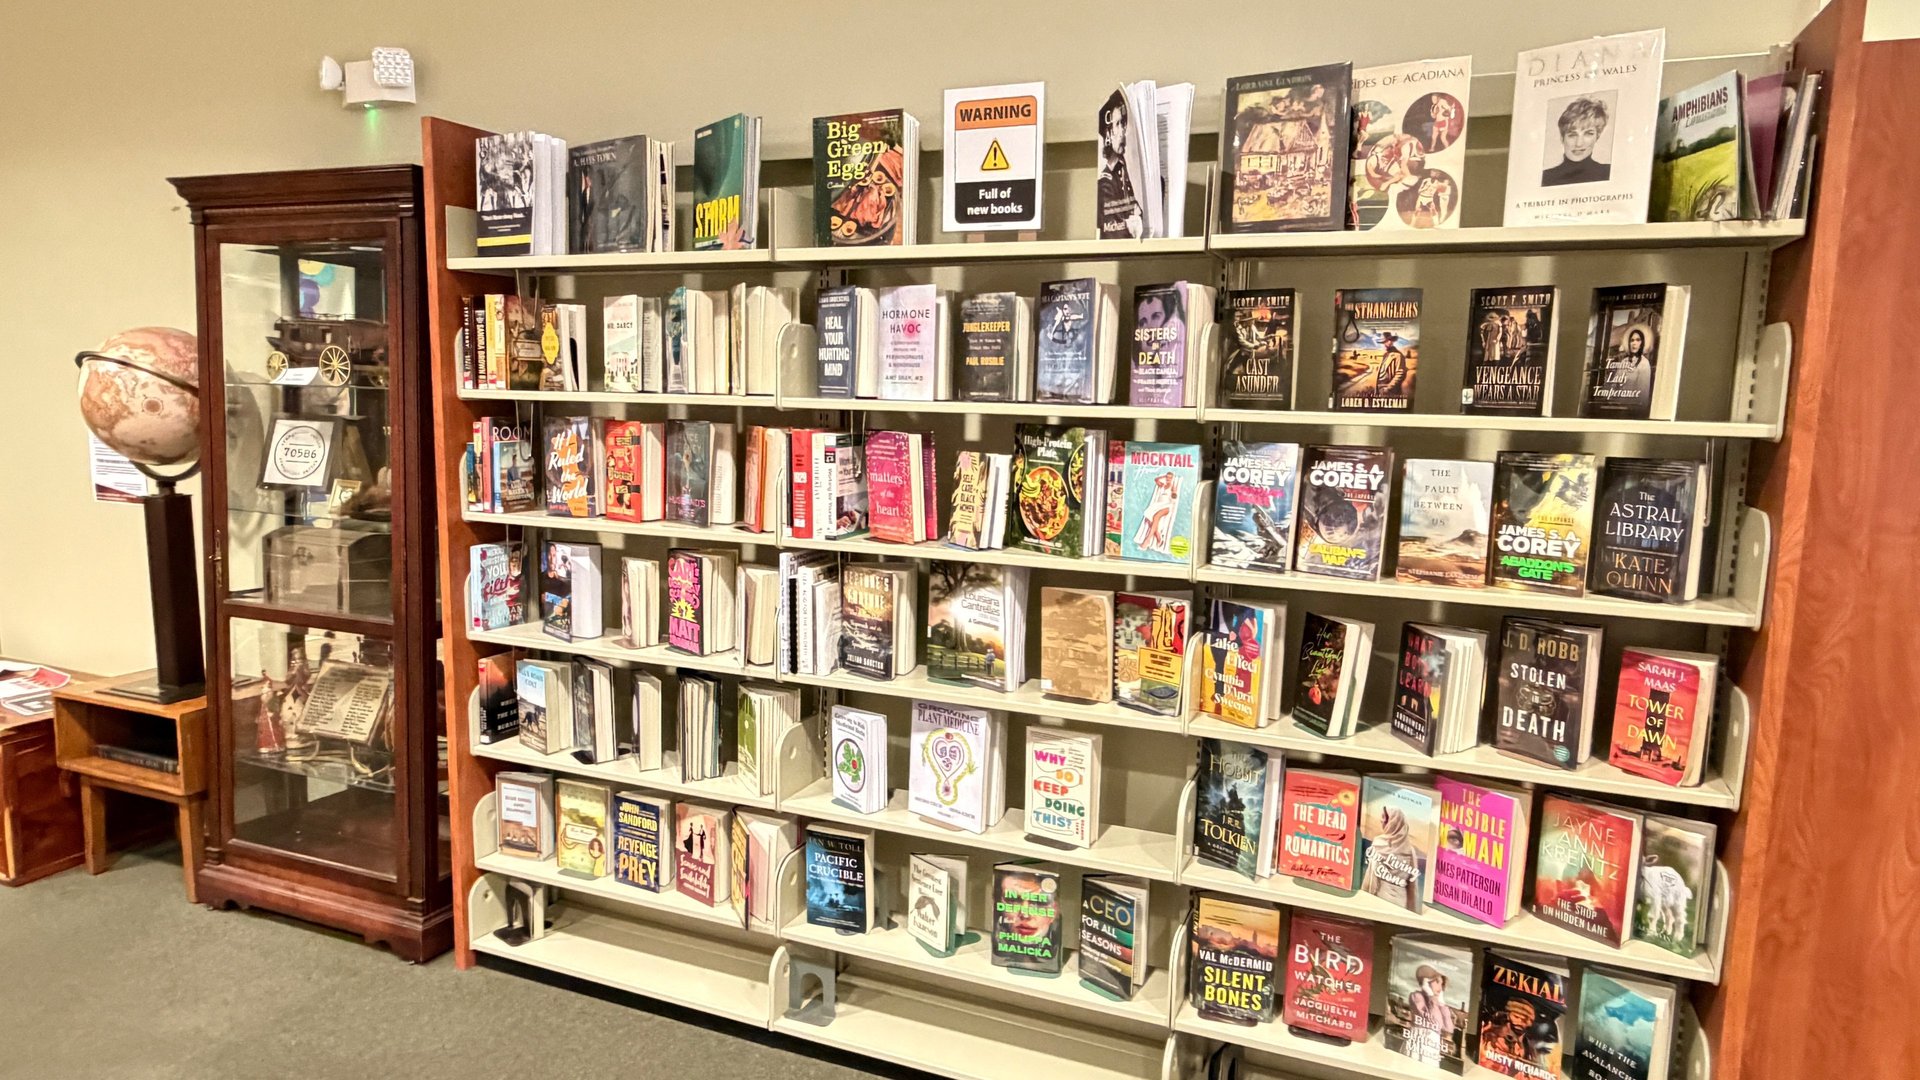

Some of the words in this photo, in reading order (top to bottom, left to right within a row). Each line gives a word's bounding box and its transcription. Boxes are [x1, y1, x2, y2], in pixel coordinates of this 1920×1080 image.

[1528, 43, 1646, 76] DIAN
[1383, 76, 1398, 86] OF
[1403, 68, 1464, 84] ACADIANA
[1532, 72, 1581, 87] PRINCESS
[1602, 64, 1637, 78] WALES
[959, 104, 1032, 122] WARNING
[1671, 86, 1728, 123] AMPHIBIANS
[827, 121, 861, 142] Big
[827, 140, 884, 158] Green
[827, 160, 867, 179] Egg
[978, 187, 998, 200] Full
[1000, 187, 1011, 199] of
[1523, 198, 1556, 208] TRIBUTE
[1570, 192, 1634, 206] PHOTOGRAPHS
[695, 194, 740, 238] STORM
[967, 206, 987, 216] new
[990, 202, 1023, 215] books
[1266, 295, 1290, 307] SMITH
[1480, 295, 1507, 307] SCOTT
[1522, 293, 1551, 306] SMITH
[881, 309, 930, 319] HORMONE
[1354, 302, 1418, 320] STRANGLERS
[825, 316, 843, 330] HEAL
[890, 323, 921, 334] HAVOC
[962, 321, 1010, 333] JUNGLEKEEPER
[824, 332, 844, 346] YOUR
[1134, 327, 1177, 341] SISTERS
[477, 350, 486, 374] BROWN
[818, 347, 850, 361] HURTING
[966, 356, 978, 365] PAUL
[1138, 352, 1176, 365] DEATH
[824, 363, 843, 376] MIND
[1246, 359, 1270, 376] CAST
[1605, 358, 1636, 371] Taming
[1235, 376, 1279, 393] ASUNDER
[1475, 366, 1541, 385] VENGEANCE
[1606, 370, 1629, 387] Lady
[1474, 385, 1505, 401] WEARS
[1516, 385, 1540, 401] STAR
[1593, 385, 1642, 399] Temperance
[1341, 397, 1362, 408] LOREN
[1372, 398, 1408, 409] ESTLEMAN
[1024, 435, 1073, 450] High-Protein
[284, 447, 317, 458] 70586
[548, 444, 585, 470] Ruled
[1036, 447, 1058, 458] Plate
[1130, 450, 1195, 468] MOCKTAIL
[1224, 457, 1263, 469] JAMES
[1311, 460, 1355, 473] JAMES
[1355, 462, 1368, 474] S.
[1370, 464, 1384, 475] A.
[1430, 468, 1451, 477] THE
[870, 471, 904, 485] matters
[1223, 467, 1292, 487] COREY
[1309, 470, 1384, 490] COREY
[551, 478, 589, 503] World
[1424, 485, 1458, 494] FAULT
[1639, 491, 1656, 502] The
[876, 504, 900, 516] heart
[1413, 501, 1463, 511] BETWEEN
[1609, 502, 1683, 524] ASTRAL
[1498, 524, 1546, 538] JAMES
[1549, 528, 1562, 539] S.
[1564, 531, 1581, 542] A.
[1605, 520, 1685, 543] LIBRARY
[1496, 535, 1582, 558] COREY
[1321, 553, 1349, 566] WAR
[1500, 555, 1575, 574] ABADDON'S
[1614, 553, 1669, 575] KATE
[487, 564, 508, 579] YOU
[1517, 566, 1554, 580] GATE
[1606, 570, 1673, 594] QUINN
[1205, 633, 1239, 654] Lake
[1502, 630, 1513, 649] J.
[1519, 633, 1530, 652] D.
[1537, 637, 1580, 663] ROBB
[1204, 668, 1244, 688] Cynthia
[1510, 662, 1566, 690] STOLEN
[1637, 661, 1676, 680] SARAH
[1399, 670, 1432, 698] LEARN
[1643, 676, 1677, 692] MAAS
[917, 702, 980, 721] GROWING
[1628, 694, 1684, 721] TOWER
[917, 709, 941, 727] PLANT
[1502, 706, 1566, 743] DEATH
[1646, 715, 1664, 728] OF
[1627, 724, 1678, 750] DAWN
[1034, 749, 1067, 766] WHY
[1210, 753, 1263, 786] HOBBIT
[1033, 779, 1069, 796] KEEP
[1462, 787, 1481, 808] THE
[619, 802, 640, 815] JOHN
[1045, 797, 1085, 818] DOING
[1293, 803, 1314, 824] THE
[1318, 808, 1347, 831] DEAD
[618, 812, 658, 832] SANDFORD
[1033, 810, 1072, 830] THIS?
[1441, 798, 1507, 840] NVISIBLE
[1200, 818, 1257, 855] TOLKIEN
[1553, 814, 1617, 846] JAYNE
[617, 836, 658, 859] REVENGE
[1285, 833, 1350, 866] ROMANTICS
[1559, 831, 1606, 859] ANN
[618, 852, 656, 888] PREY
[814, 852, 858, 869] PACIFIC
[1542, 841, 1621, 880] KRENTZ
[808, 864, 864, 882] CRUCIBLE
[1374, 864, 1408, 888] Stone
[1455, 864, 1501, 897] PATTERSON
[1004, 890, 1018, 899] IN
[1021, 891, 1048, 903] HER
[1435, 879, 1460, 901] SUSAN
[996, 902, 1055, 918] DEFENSE
[1083, 899, 1089, 910] A
[1089, 894, 1132, 927] CEO
[1556, 897, 1571, 912] THE
[1574, 903, 1598, 919] SHOP
[1082, 915, 1100, 931] FOR
[1101, 923, 1117, 939] ALL
[1543, 904, 1554, 916] ON
[1554, 907, 1585, 929] HIDDEN
[1586, 921, 1608, 938] LANE
[998, 931, 1052, 947] PHILIPPA
[1081, 929, 1123, 957] SEASONS
[1320, 932, 1341, 944] THE
[998, 944, 1053, 959] MALICKA
[1199, 949, 1217, 963] VAL
[1219, 953, 1273, 973] McDERMID
[1294, 943, 1365, 976] BIRD
[1204, 966, 1266, 992] SILENT
[1294, 971, 1363, 995] WATCHER
[1493, 964, 1566, 1005] ZEKIAL
[1204, 984, 1263, 1011] BONES
[1294, 997, 1358, 1019] JACQUELYN
[1295, 1010, 1354, 1031] MITCHARD
[1588, 1035, 1615, 1056] WHEN
[1616, 1052, 1638, 1070] THE
[1484, 1048, 1513, 1069] DUSTY
[1514, 1058, 1558, 1080] RICHARDS
